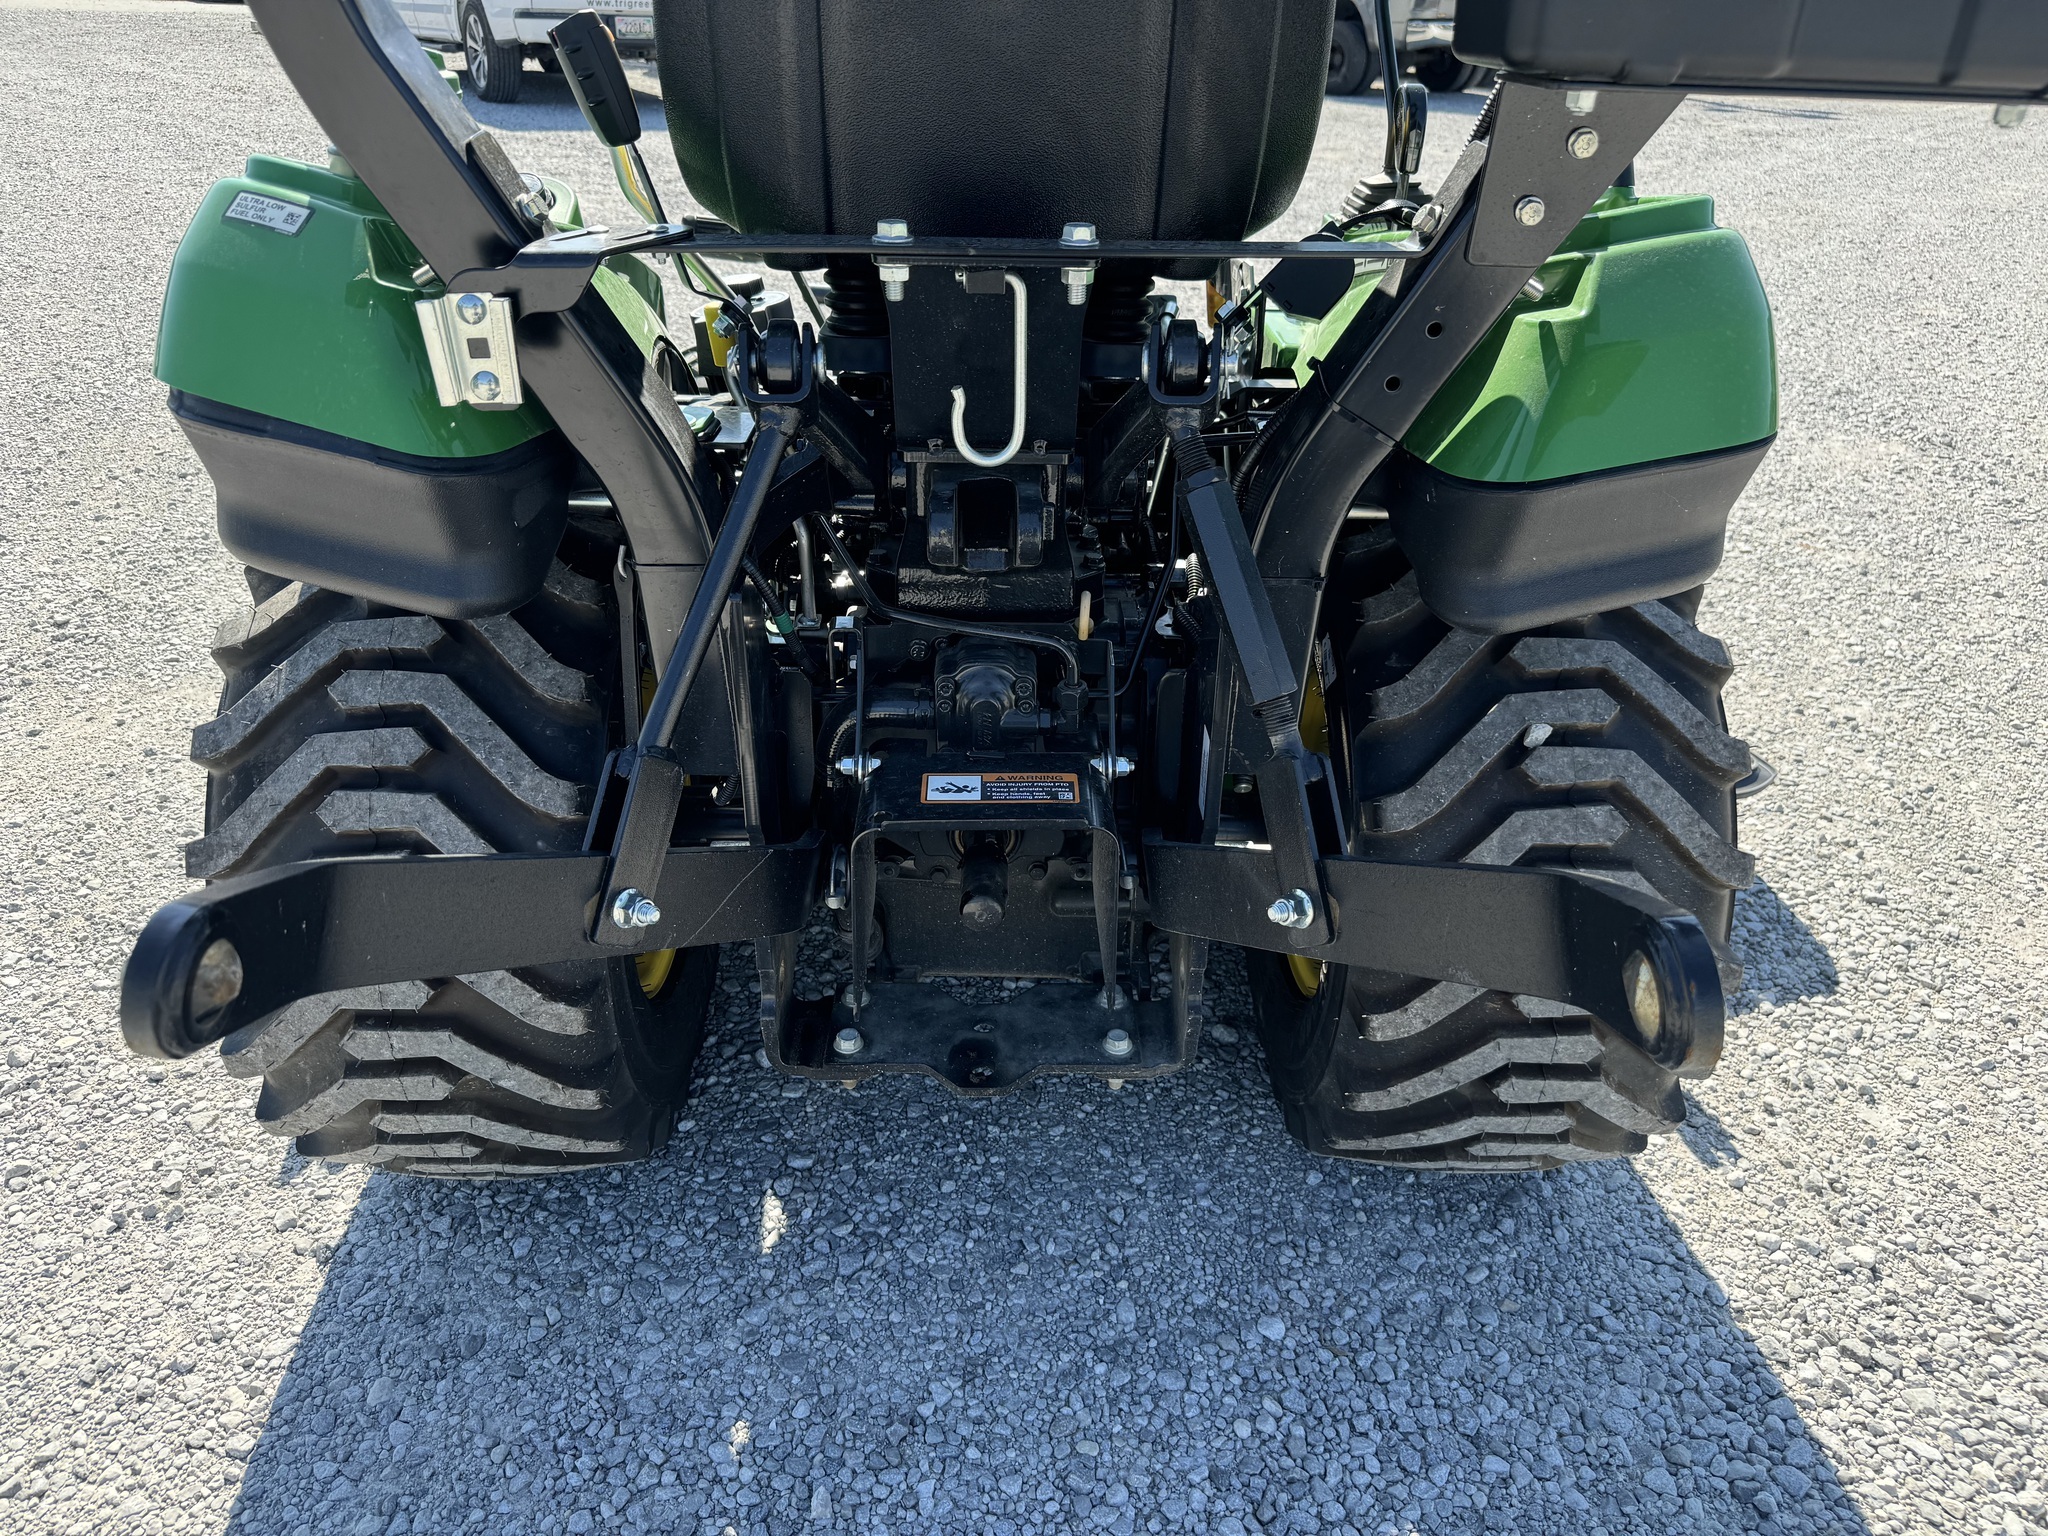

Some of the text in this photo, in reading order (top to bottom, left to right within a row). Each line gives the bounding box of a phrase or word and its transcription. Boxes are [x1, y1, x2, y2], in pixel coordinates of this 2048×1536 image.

[586, 0, 652, 9] www.trigree
[235, 202, 266, 214] SULFUR
[239, 195, 286, 211] ULTRA LOW
[230, 208, 275, 223] FUEL ONLY
